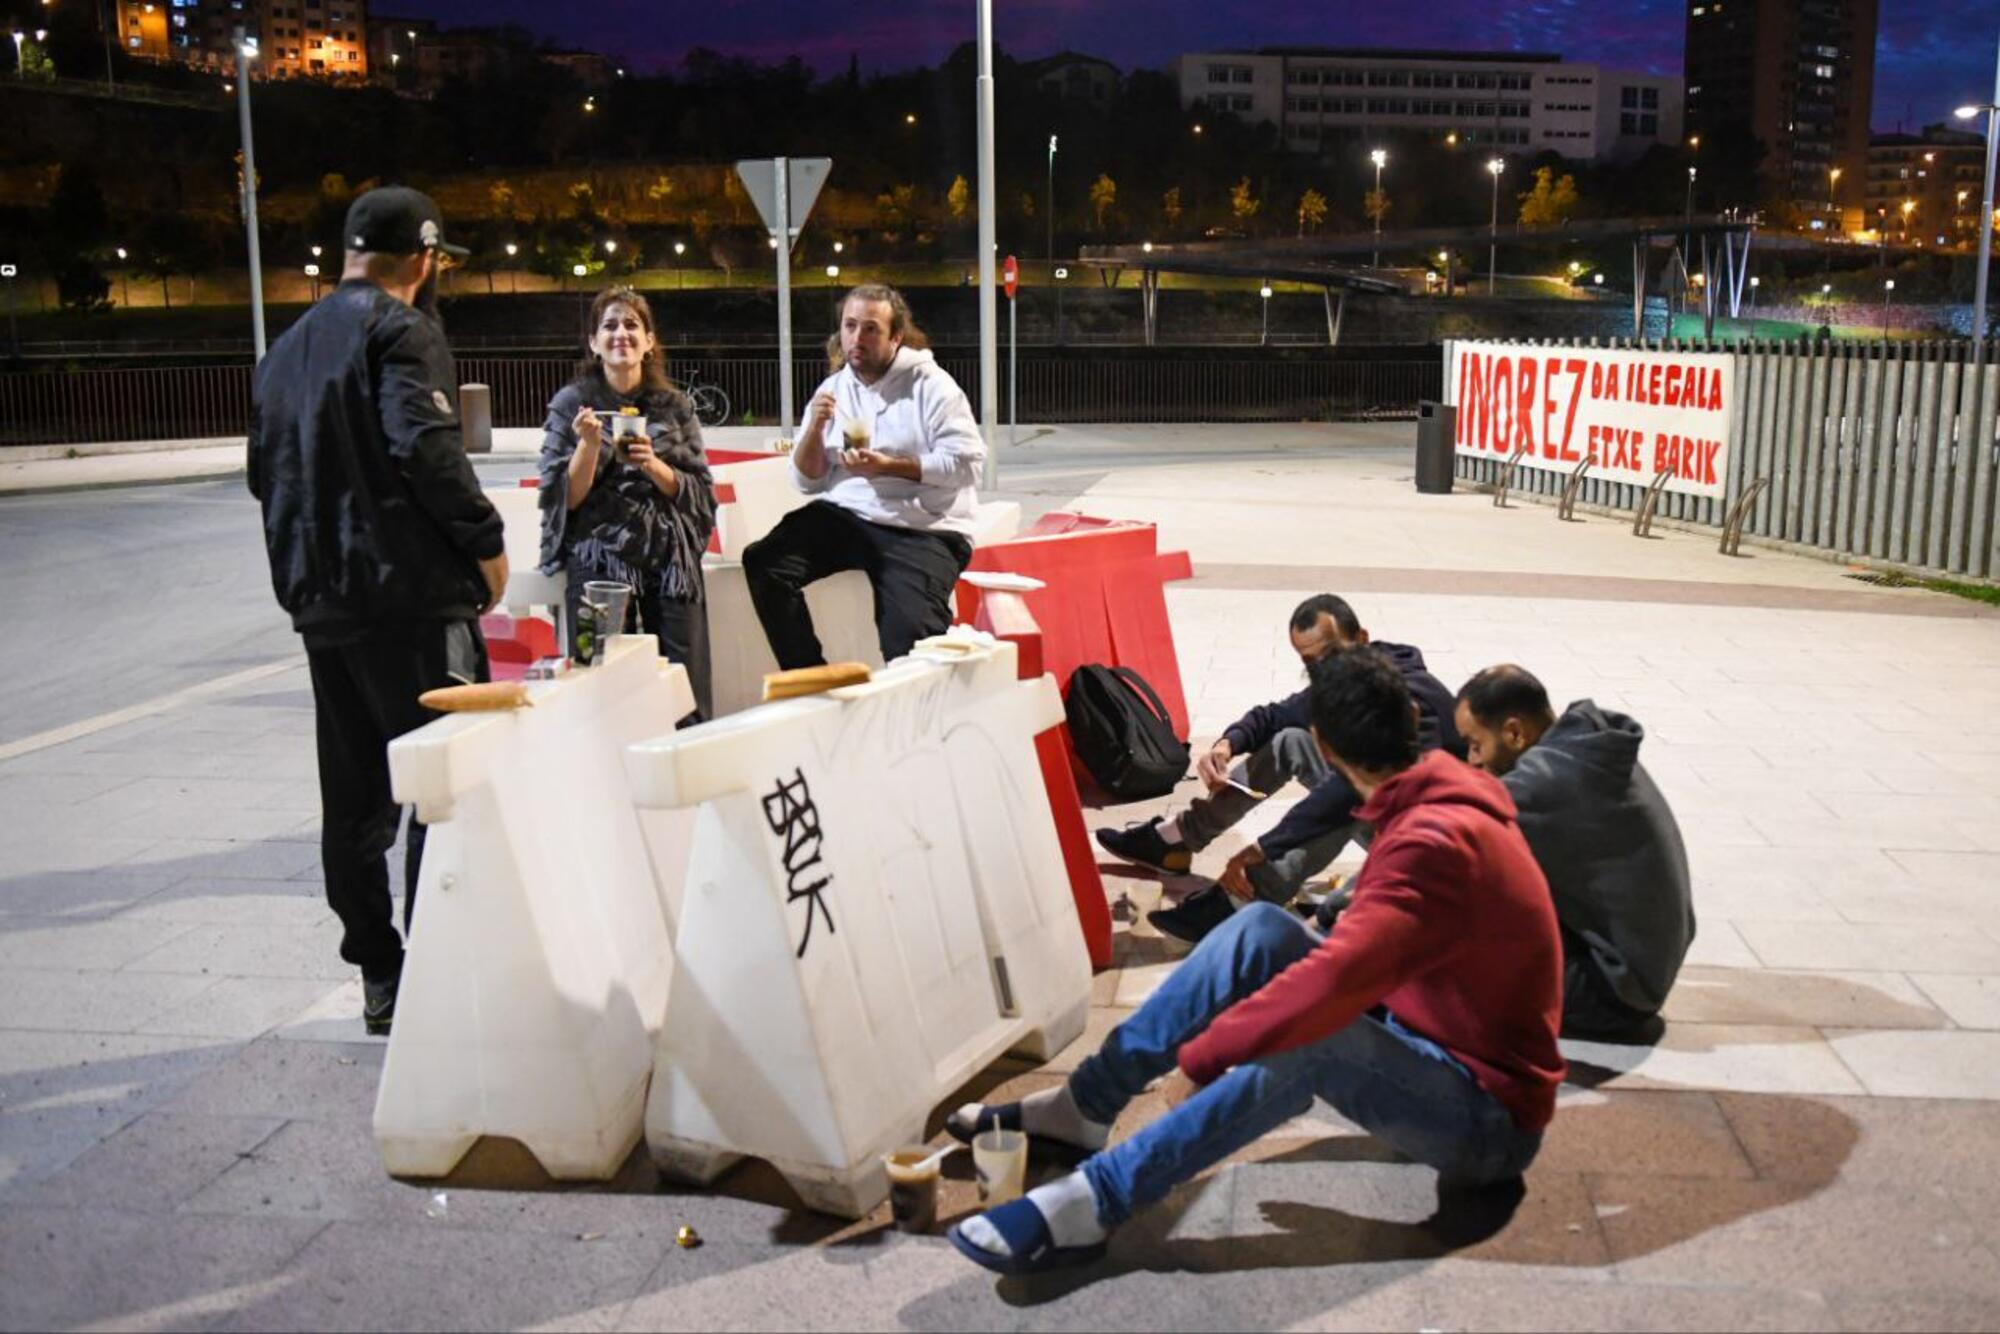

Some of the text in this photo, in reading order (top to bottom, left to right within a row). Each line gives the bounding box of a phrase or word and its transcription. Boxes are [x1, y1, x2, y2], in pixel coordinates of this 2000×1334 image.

[1591, 362, 1619, 401] DA
[1626, 363, 1723, 411] ILEGALA
[1588, 425, 1722, 485] ETXE BARIK
